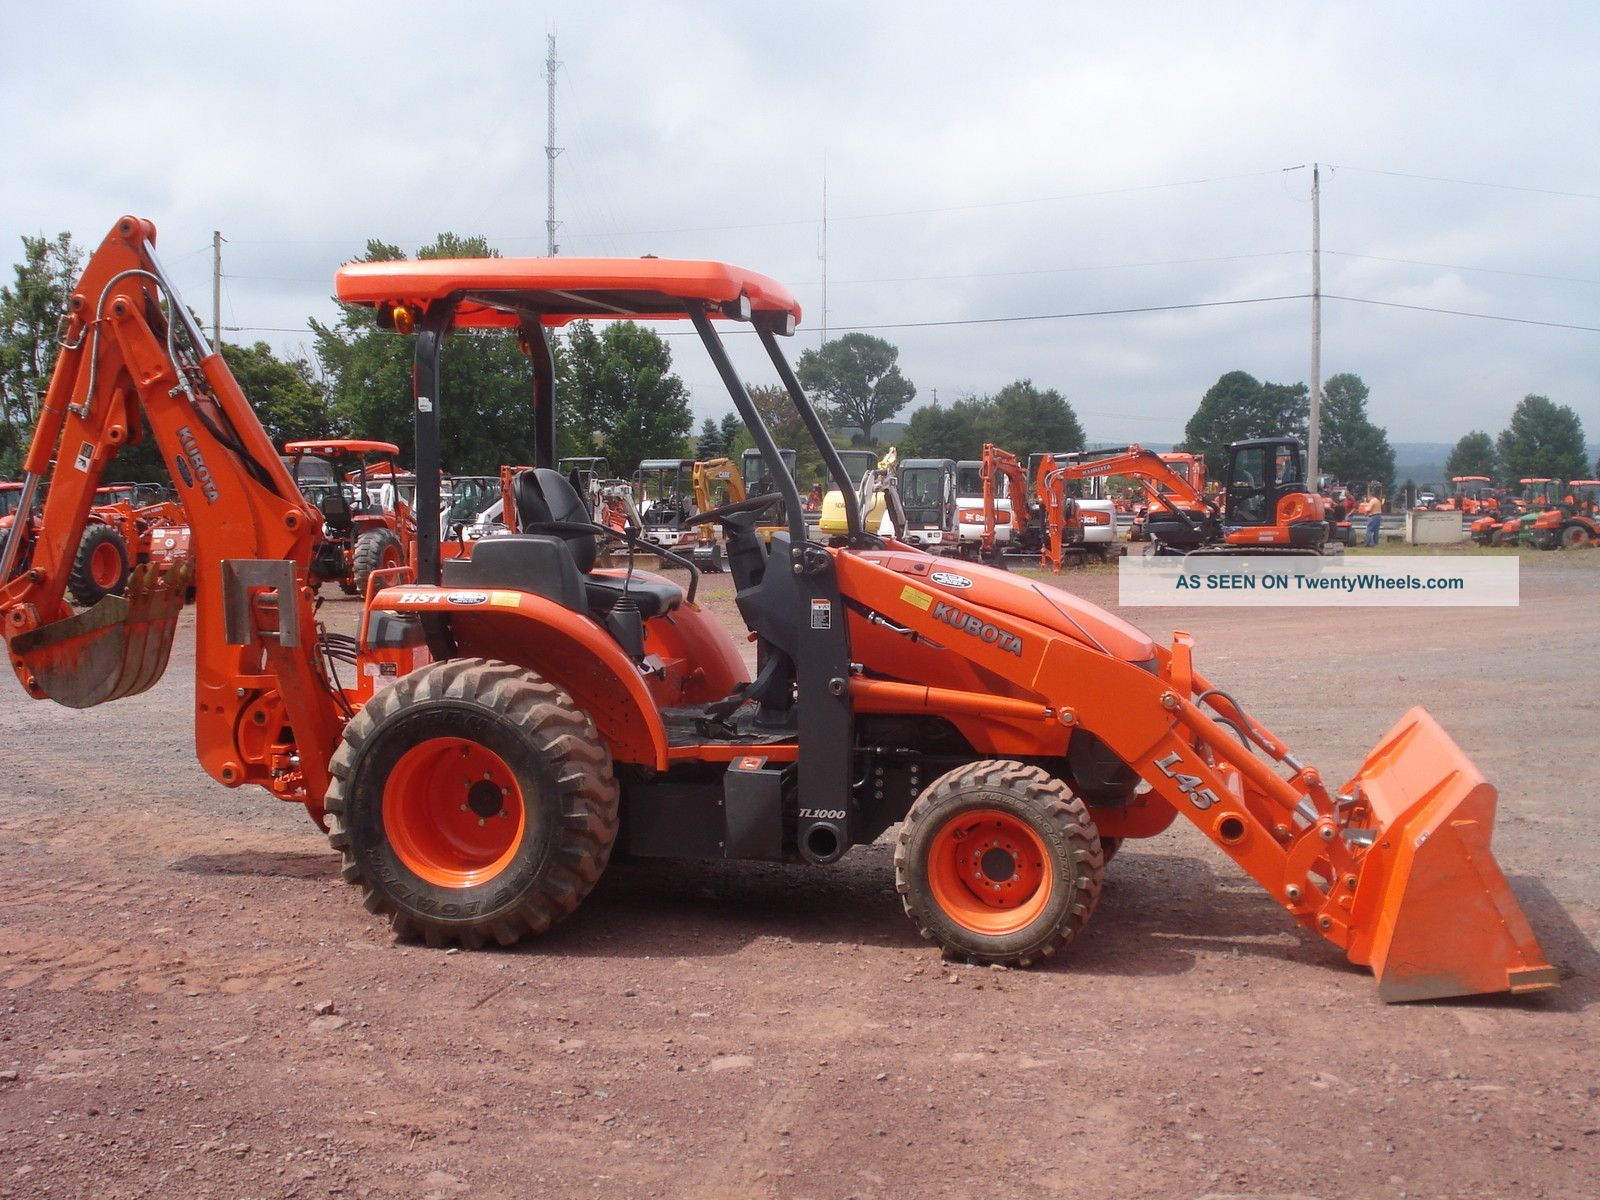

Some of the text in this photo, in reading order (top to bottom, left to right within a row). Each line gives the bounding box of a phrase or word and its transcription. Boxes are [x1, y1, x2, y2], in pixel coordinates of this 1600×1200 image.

[176, 426, 220, 505] KUBOTA
[398, 593, 446, 604] HST
[932, 601, 1023, 657] KUBOTA
[1153, 750, 1220, 810] L45
[799, 808, 847, 819] TL1000
